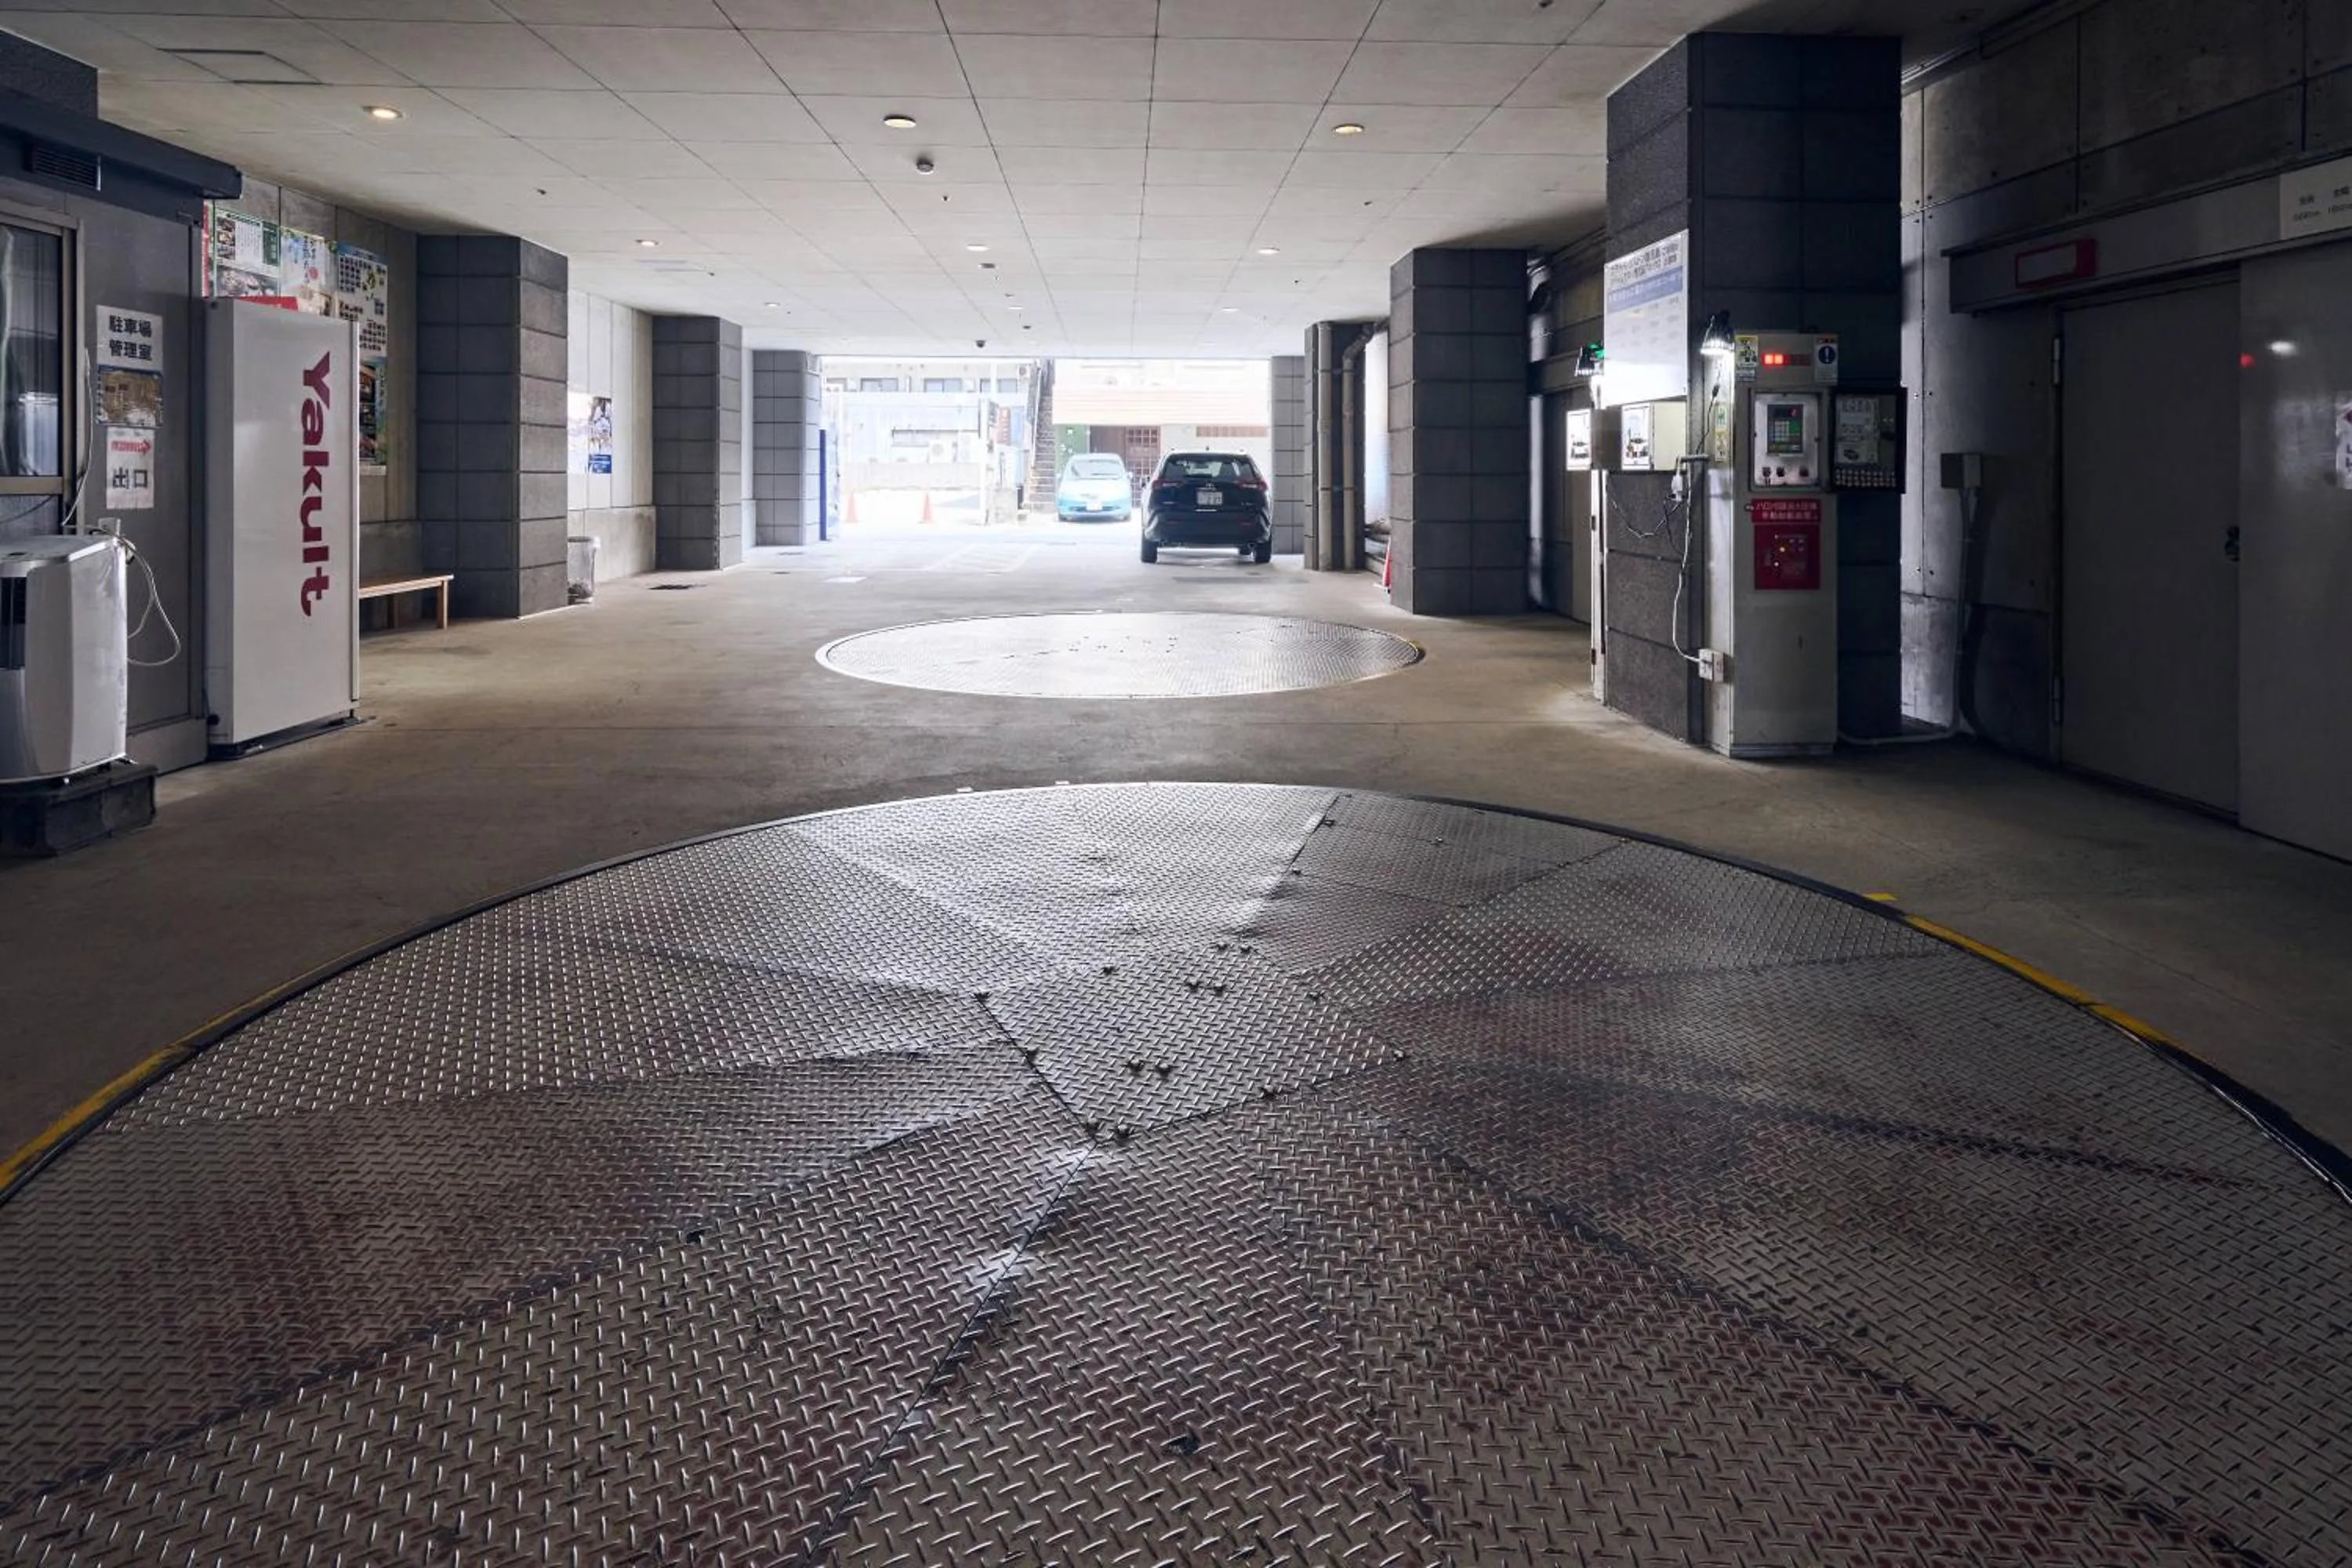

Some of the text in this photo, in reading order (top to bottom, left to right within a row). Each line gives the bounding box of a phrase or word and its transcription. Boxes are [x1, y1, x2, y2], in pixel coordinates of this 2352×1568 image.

[109, 315, 152, 338] 駐車場
[109, 339, 152, 361] 管理室
[113, 467, 149, 490] 出口
[299, 351, 330, 616] Yakult
